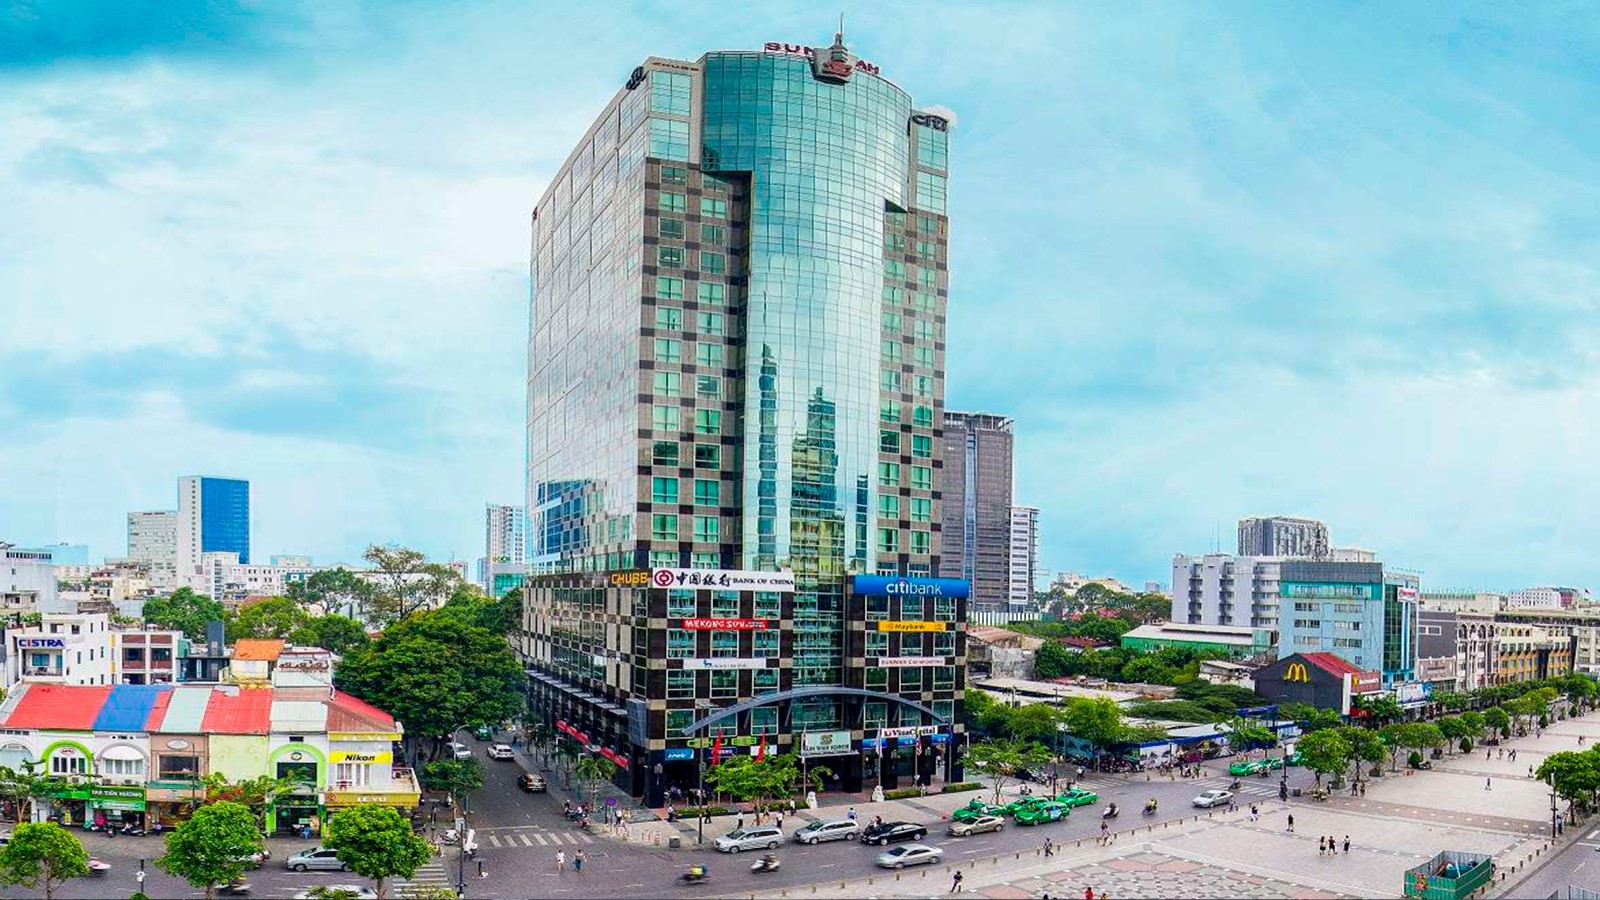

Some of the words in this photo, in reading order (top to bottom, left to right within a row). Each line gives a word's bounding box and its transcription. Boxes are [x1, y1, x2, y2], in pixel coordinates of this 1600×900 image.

[856, 60, 880, 75] AH
[611, 572, 649, 585] CHUBB
[886, 581, 942, 595] citibank
[684, 620, 725, 628] MEKONG
[18, 638, 65, 647] CISTRA
[344, 754, 375, 762] Nikon
